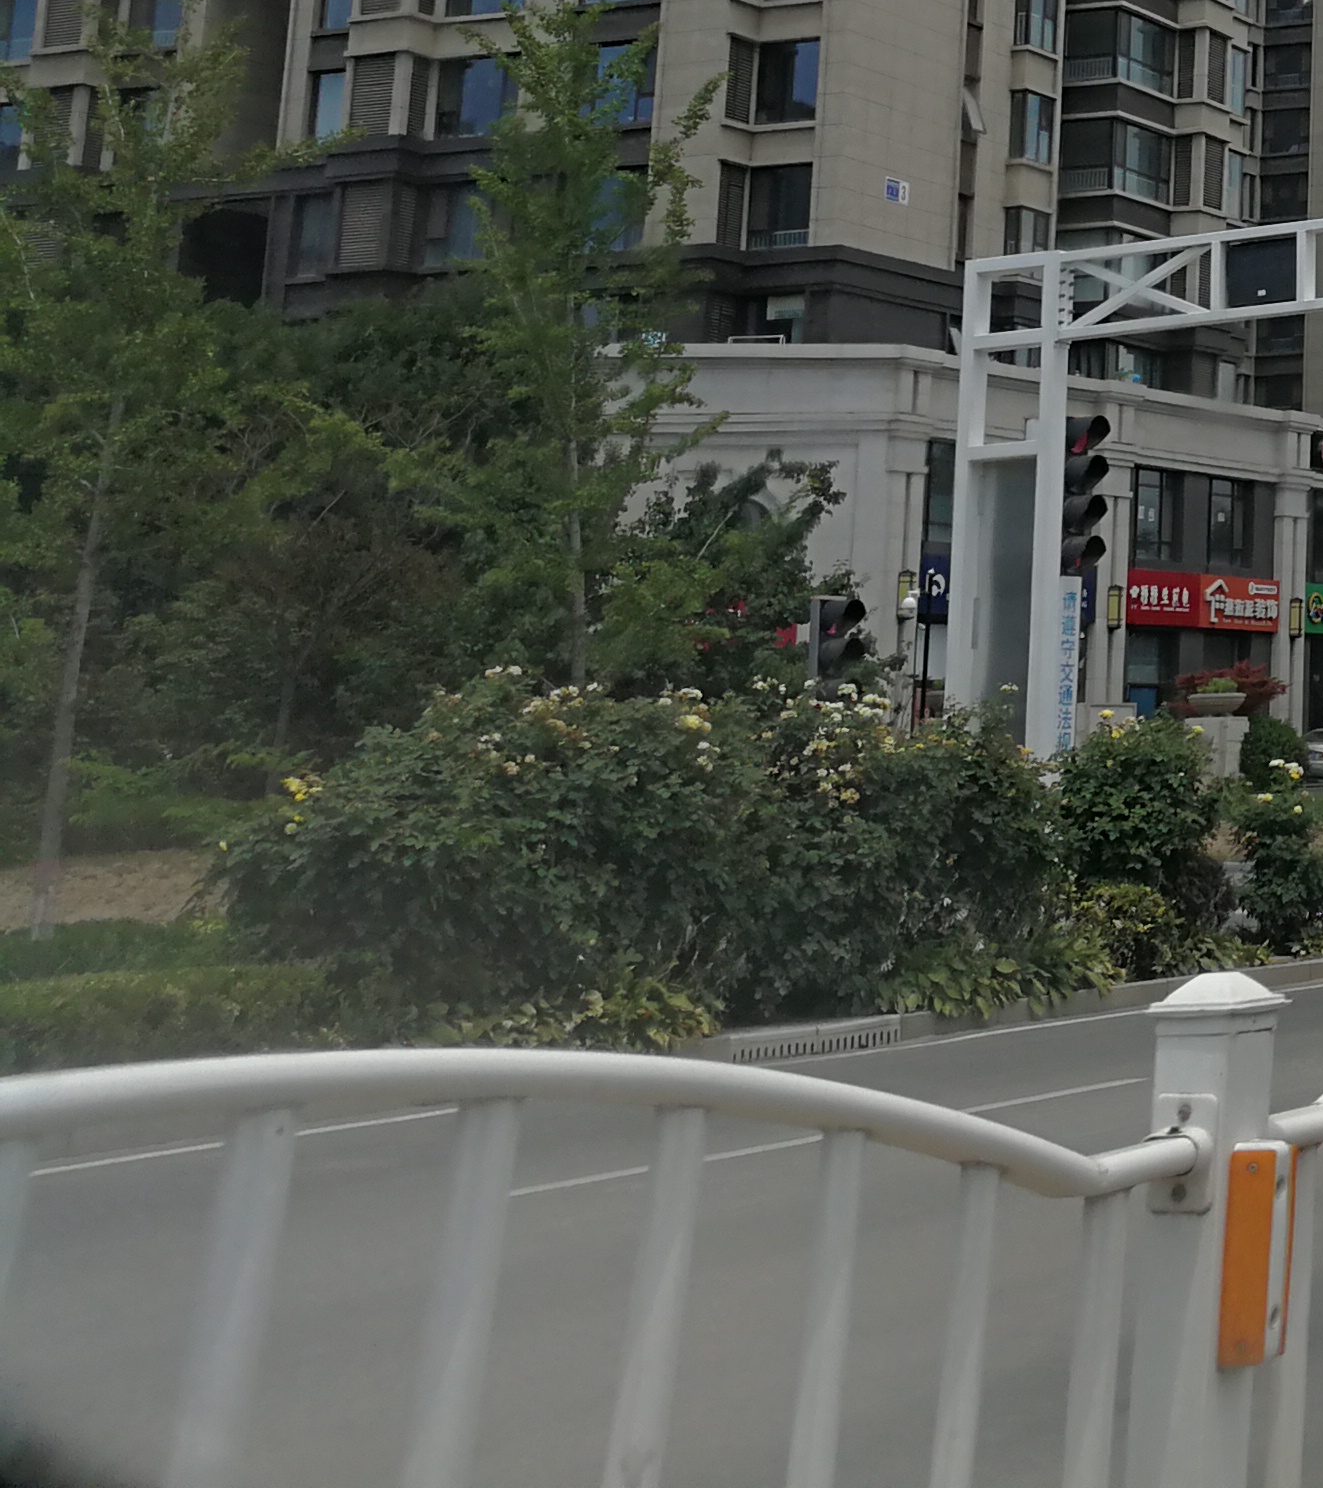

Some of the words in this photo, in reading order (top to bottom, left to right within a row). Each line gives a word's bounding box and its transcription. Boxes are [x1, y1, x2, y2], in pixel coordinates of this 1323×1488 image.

[1055, 591, 1078, 752] 请遵守交通法规
